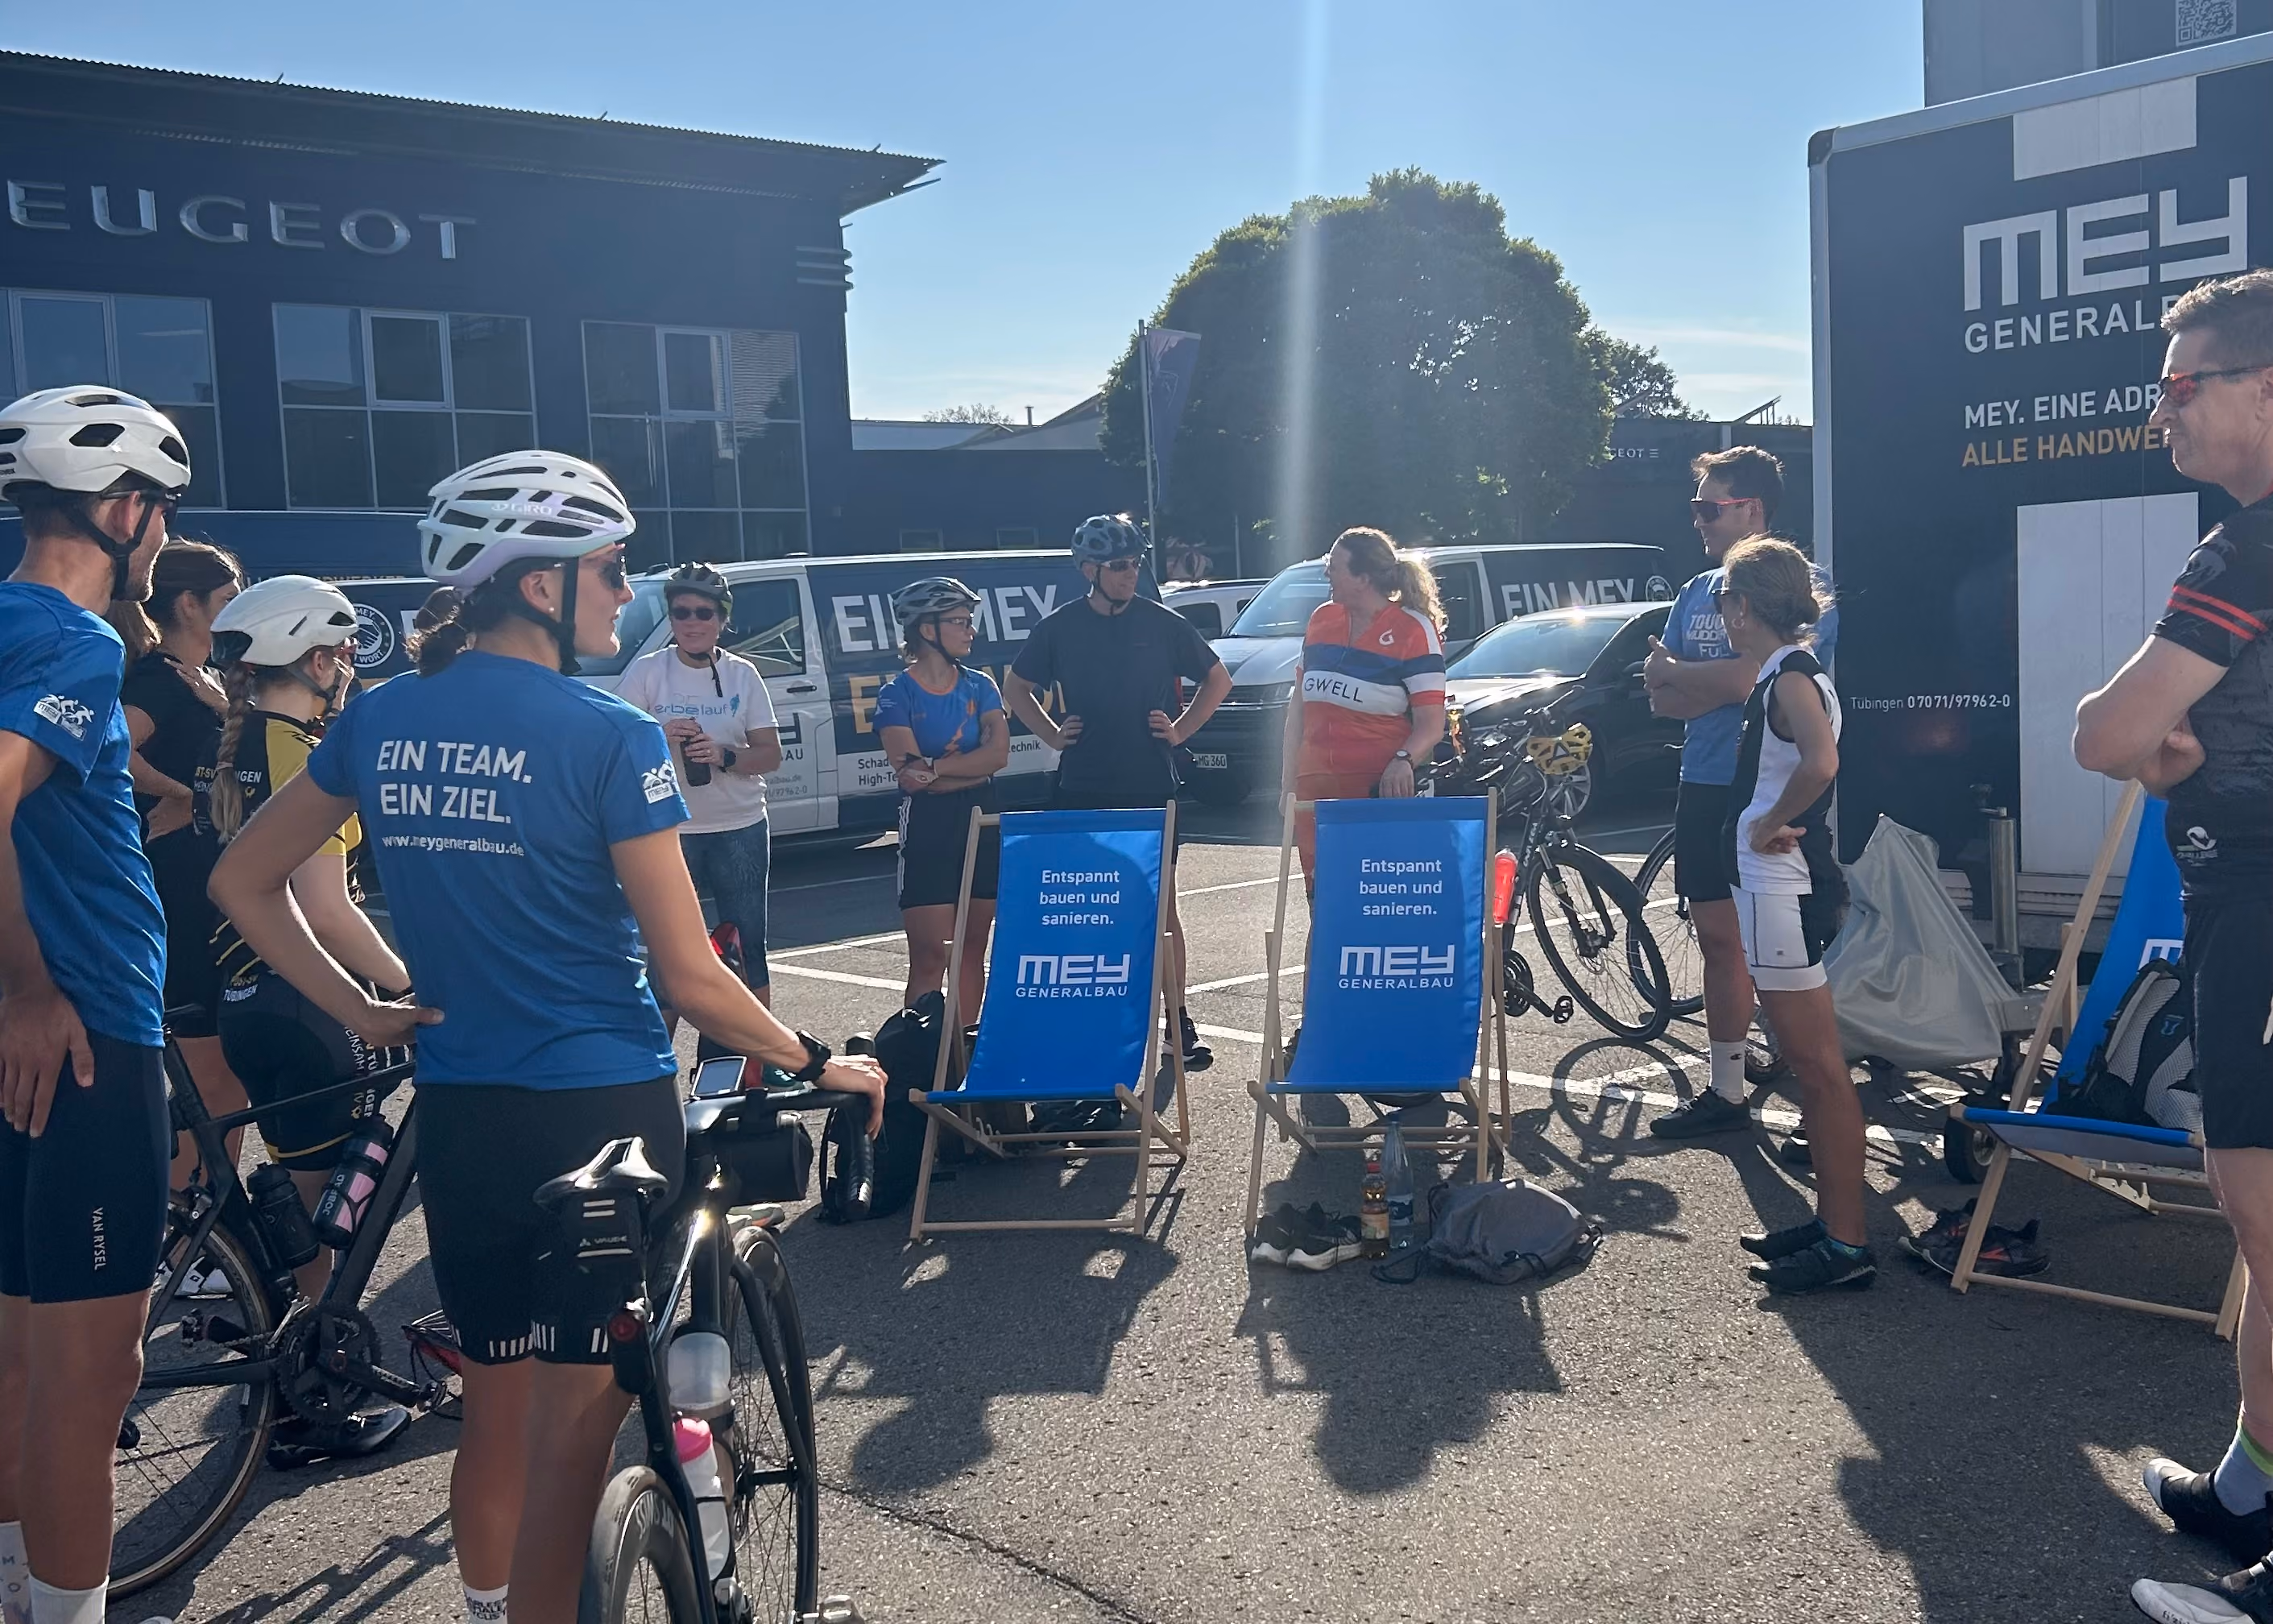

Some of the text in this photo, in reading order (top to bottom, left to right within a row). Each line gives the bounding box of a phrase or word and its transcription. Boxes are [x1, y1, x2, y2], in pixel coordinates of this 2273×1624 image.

[6, 179, 476, 259] EUGEOT
[1964, 176, 2248, 311] MEY
[1965, 383, 2162, 429] MEY. EINE ADR
[1608, 447, 1645, 458] GEOT
[1961, 437, 2028, 467] ALLE
[1850, 696, 1904, 712] Tübingen
[377, 740, 532, 784] EIN TEAM.
[380, 783, 512, 824] EIN ZIEL.
[1361, 859, 1442, 876] Entspannt
[1041, 870, 1120, 886] Entspannt
[1360, 880, 1443, 894] bauen und
[1039, 891, 1120, 905] bauen und
[1362, 901, 1437, 916] sanieren.
[1041, 911, 1114, 925] sanieren.
[1016, 954, 1131, 984] MEY
[1339, 945, 1455, 976] MEY
[1015, 985, 1128, 998] GENERALBAU
[1338, 977, 1454, 989] GENERALBAU
[93, 1207, 106, 1270] VAN RYSEL
